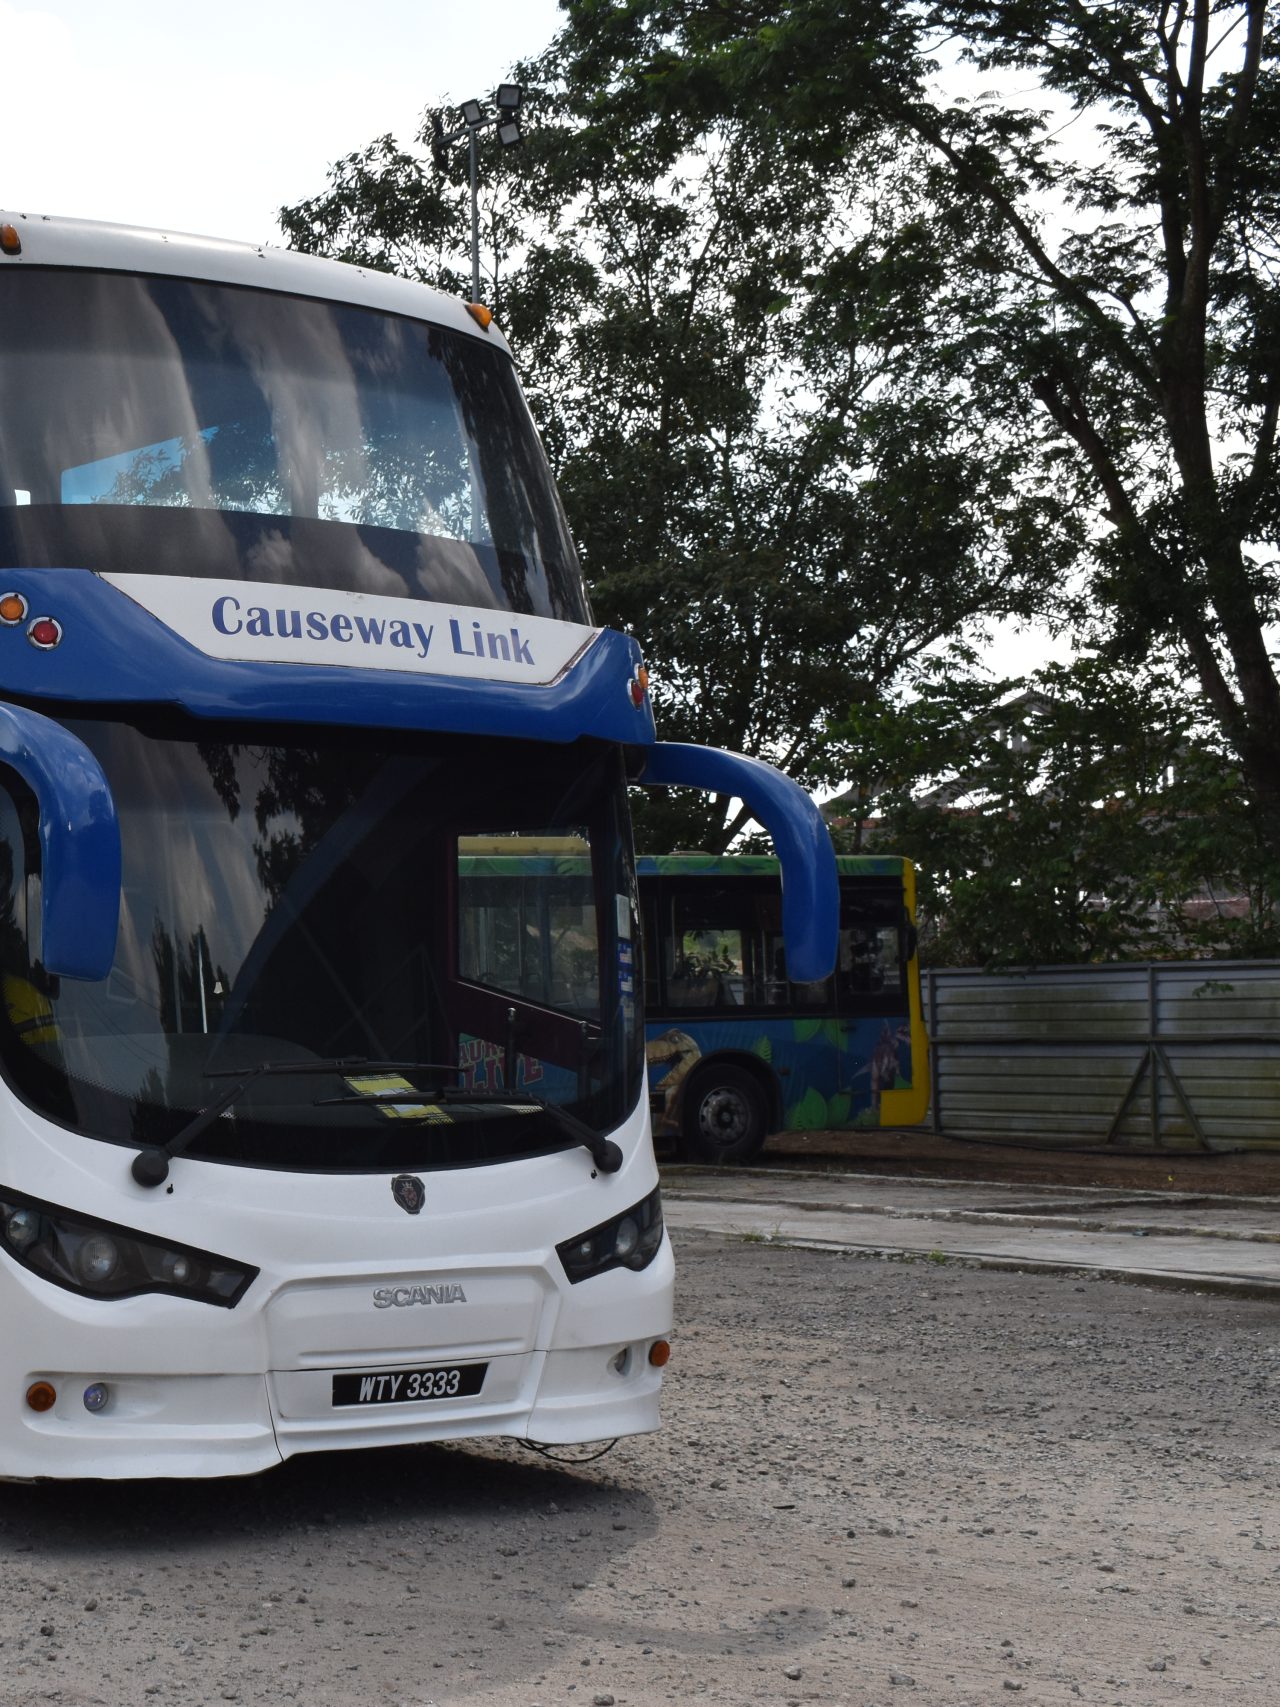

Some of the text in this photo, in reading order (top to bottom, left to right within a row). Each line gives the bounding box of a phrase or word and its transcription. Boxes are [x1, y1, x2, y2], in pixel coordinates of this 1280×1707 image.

[211, 595, 536, 665] Causeway Link
[373, 1283, 467, 1308] SCANIA
[359, 1370, 461, 1402] WTY 3333
